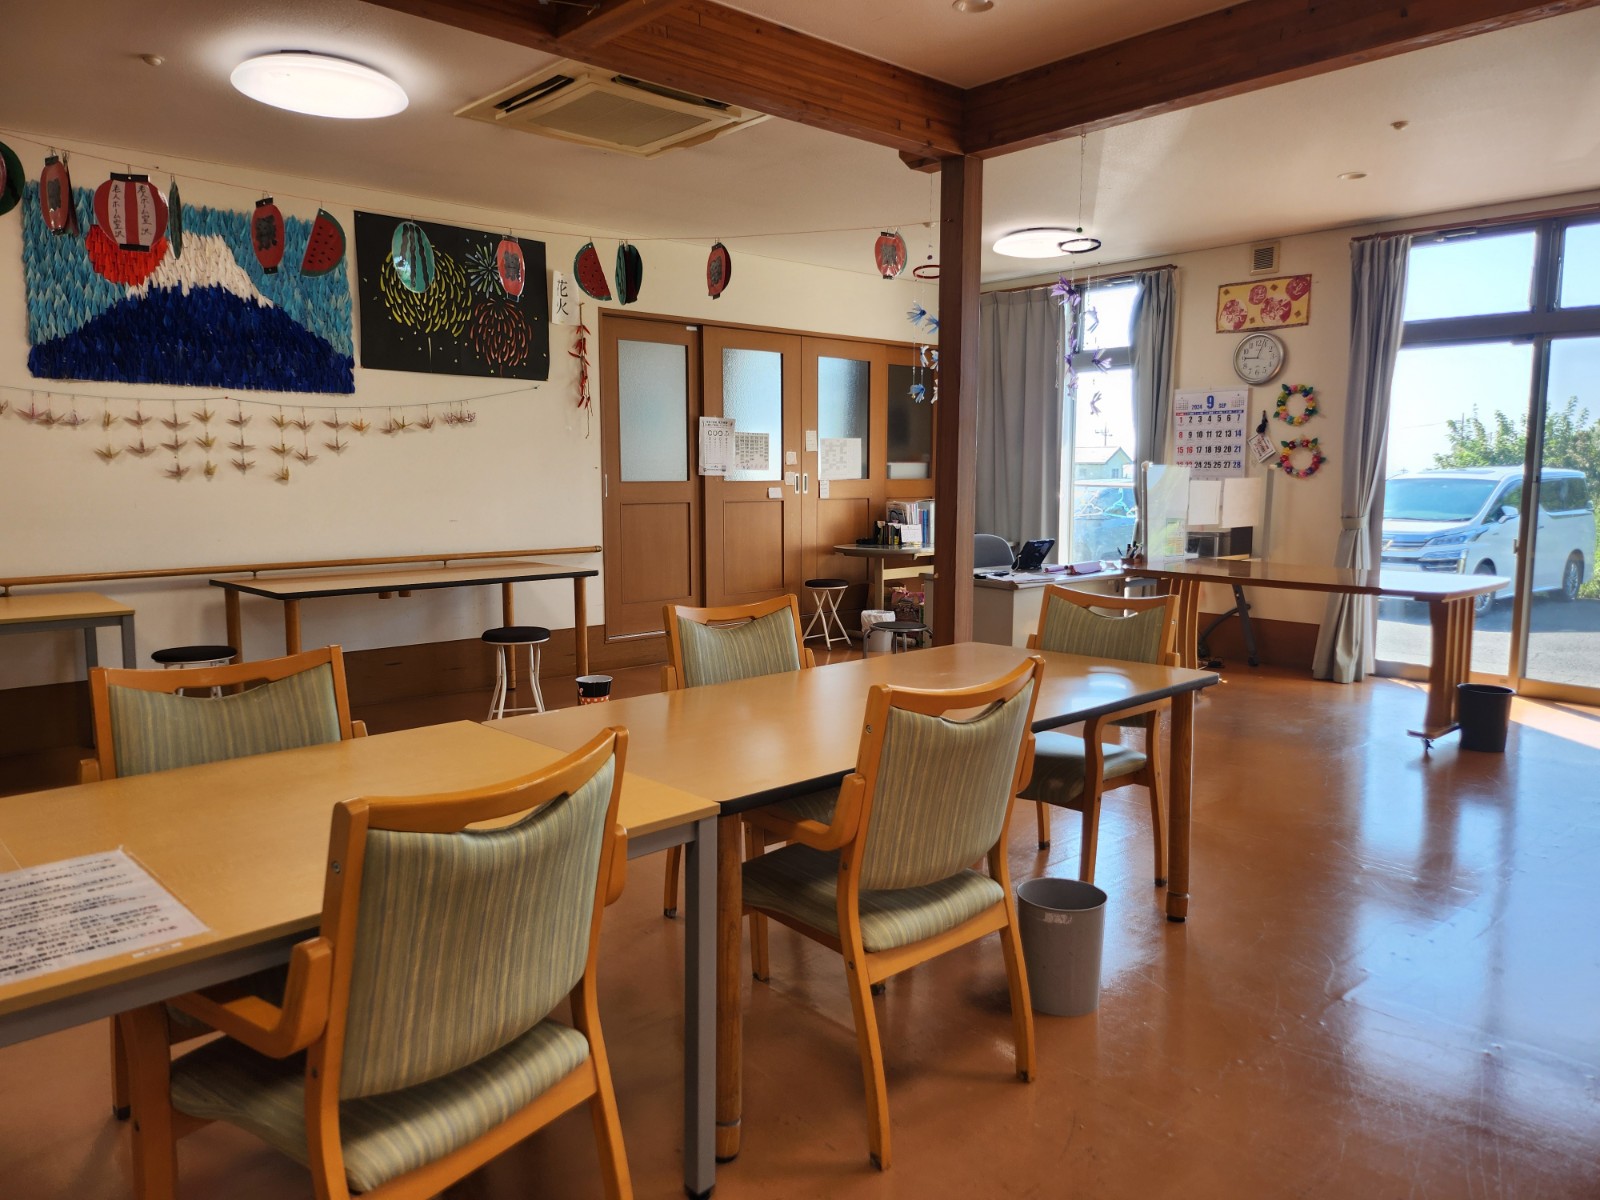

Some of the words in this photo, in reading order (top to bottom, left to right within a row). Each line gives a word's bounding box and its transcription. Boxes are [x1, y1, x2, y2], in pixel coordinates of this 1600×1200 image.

[556, 279, 569, 316] 花火
[1207, 395, 1214, 409] 9
[1215, 430, 1222, 438] 12
[1225, 430, 1232, 438] 13
[1177, 446, 1184, 454] 15
[1186, 446, 1193, 454] 16
[1232, 460, 1241, 468] 28
